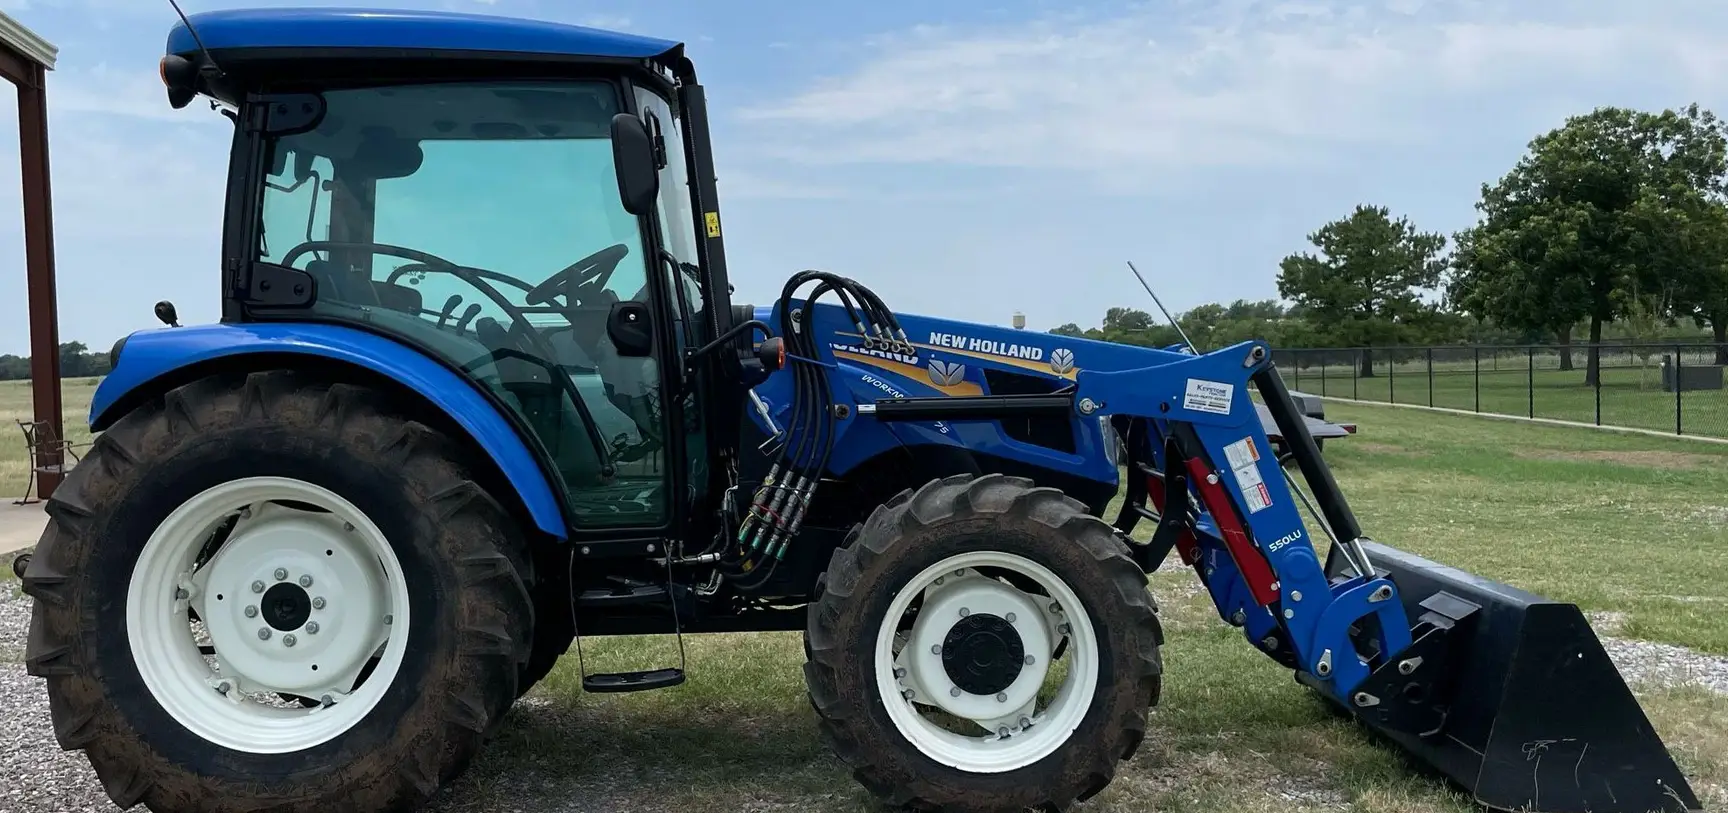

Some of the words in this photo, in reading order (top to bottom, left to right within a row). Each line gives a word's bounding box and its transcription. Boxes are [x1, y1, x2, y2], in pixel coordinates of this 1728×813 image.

[929, 332, 967, 349] NEW
[969, 338, 1043, 360] HOLLAND
[1269, 529, 1302, 552] 550LU
